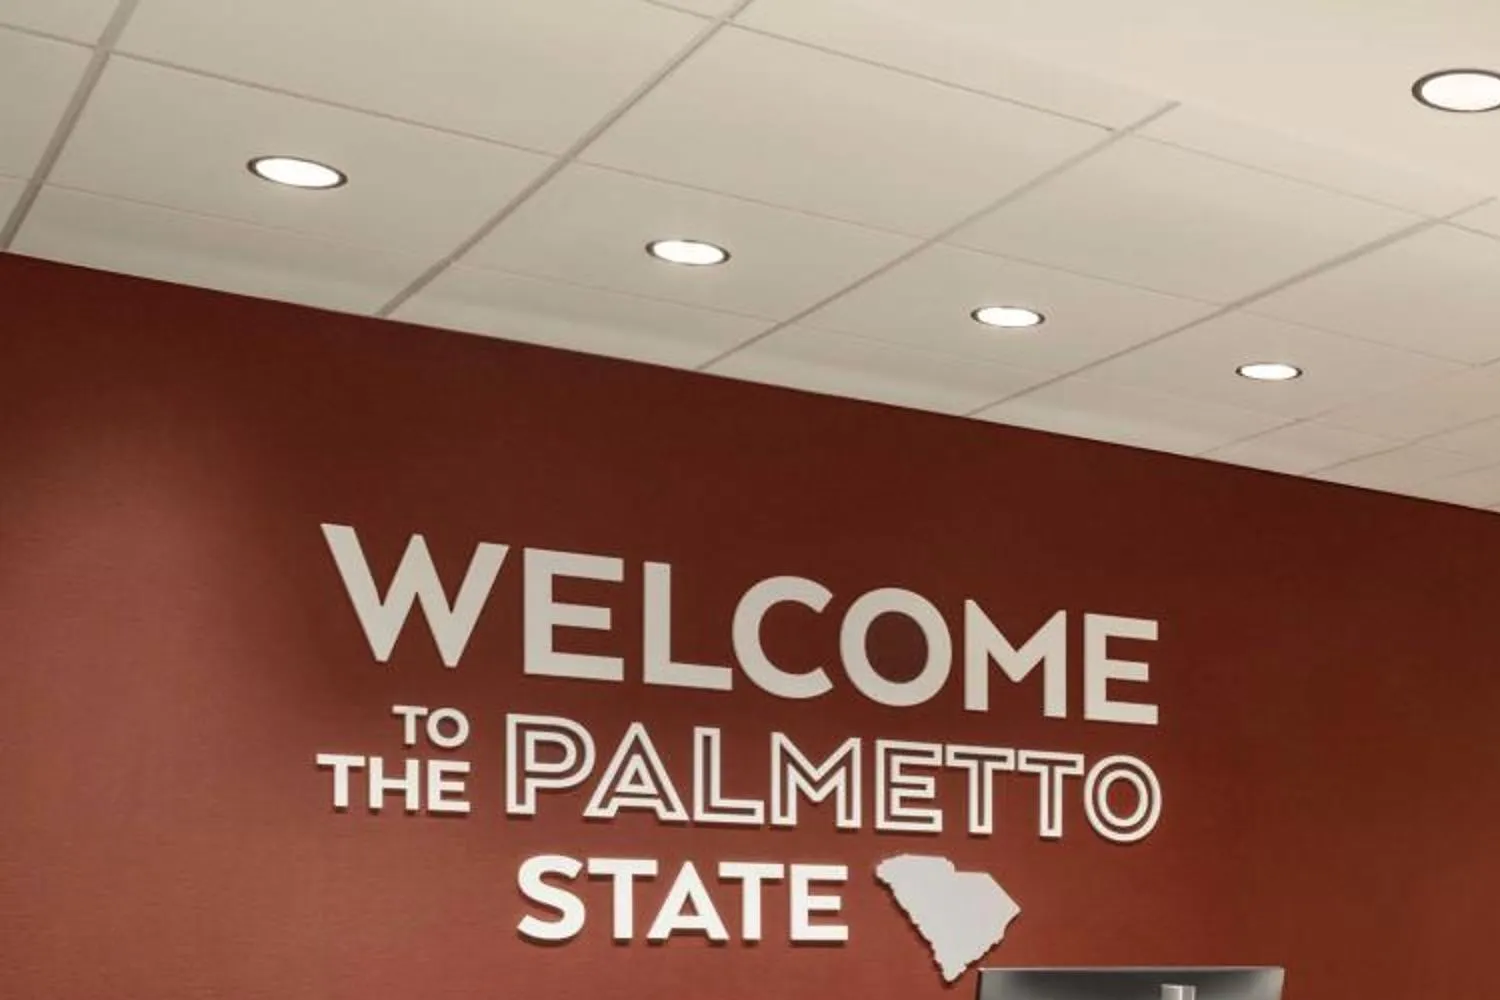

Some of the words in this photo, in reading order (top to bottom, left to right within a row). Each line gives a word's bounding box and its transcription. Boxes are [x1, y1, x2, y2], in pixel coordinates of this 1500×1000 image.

[320, 522, 1159, 726] WELCOME
[316, 752, 471, 814] THE
[505, 712, 1162, 843] PALMETTO
[392, 704, 470, 748] TO
[516, 852, 849, 942] STATE
